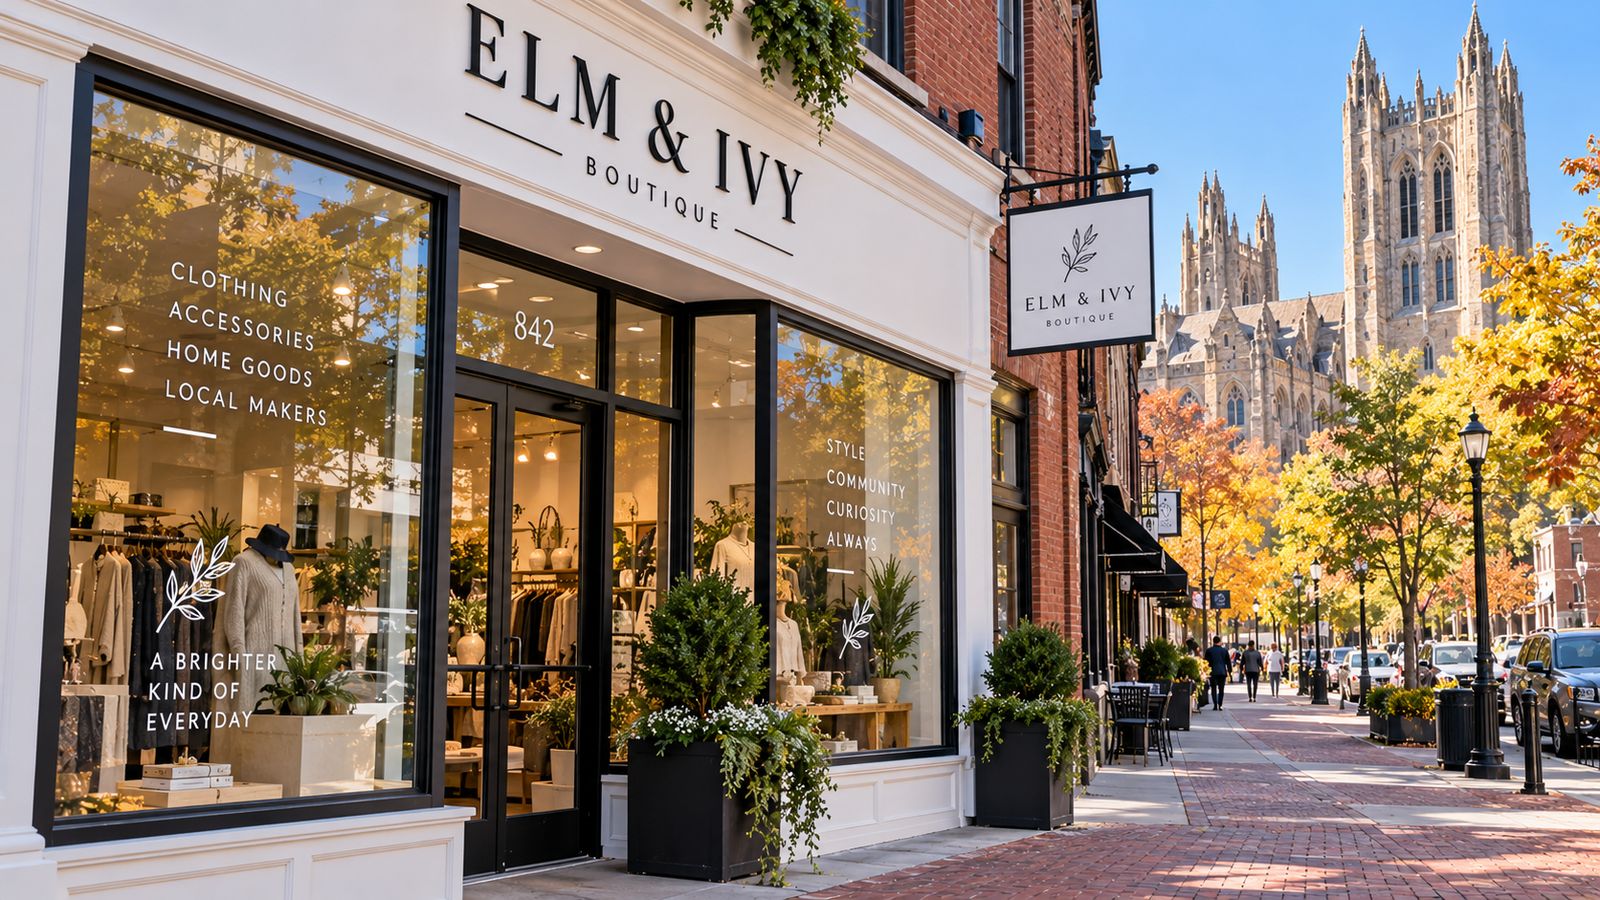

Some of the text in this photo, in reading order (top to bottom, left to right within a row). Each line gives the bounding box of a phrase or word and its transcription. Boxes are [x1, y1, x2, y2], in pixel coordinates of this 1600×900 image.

[465, 3, 803, 224] ELM & IVY
[587, 156, 718, 230] BOUTIQUE
[171, 261, 287, 308] CLOTHING
[1025, 285, 1135, 312] ELM & IVY
[169, 301, 314, 351] ACCESSORIES
[514, 310, 555, 349] 842
[1046, 312, 1115, 328] BOUTIQUE
[167, 340, 312, 388] HOME GOODS
[165, 379, 327, 426] LOCAL MAKERS
[827, 438, 865, 461] STYLE
[826, 469, 905, 499] COMMUNITY
[826, 500, 895, 525] CURIOSITY
[826, 531, 877, 551] ALWAYS
[150, 652, 277, 671] A BRIGHTER
[148, 682, 240, 700] KIND OF
[147, 710, 253, 731] EVERYDAY
